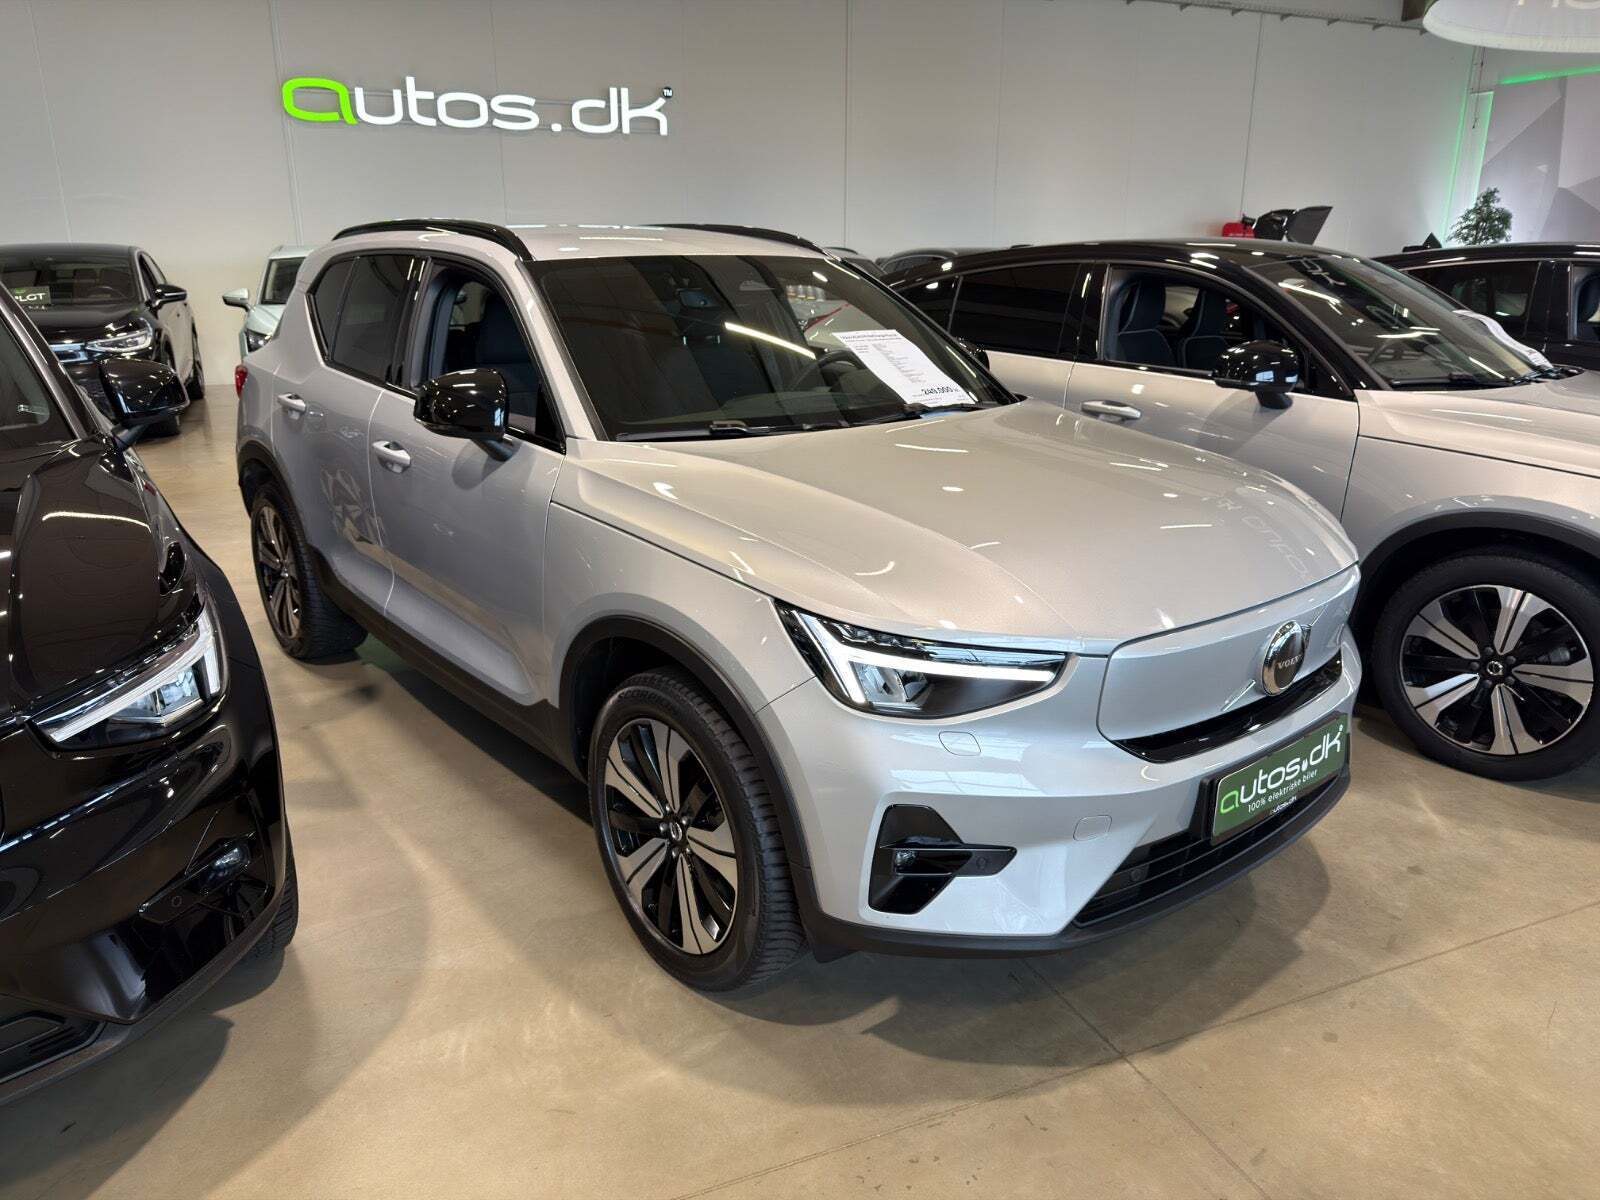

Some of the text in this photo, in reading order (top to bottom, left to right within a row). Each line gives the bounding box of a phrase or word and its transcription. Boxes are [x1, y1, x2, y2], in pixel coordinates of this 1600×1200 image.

[281, 75, 668, 136] autos.dk
[1277, 654, 1303, 670] VOLV
[1220, 729, 1343, 815] autos.dk
[1248, 768, 1318, 813] 100% elektriske biler
